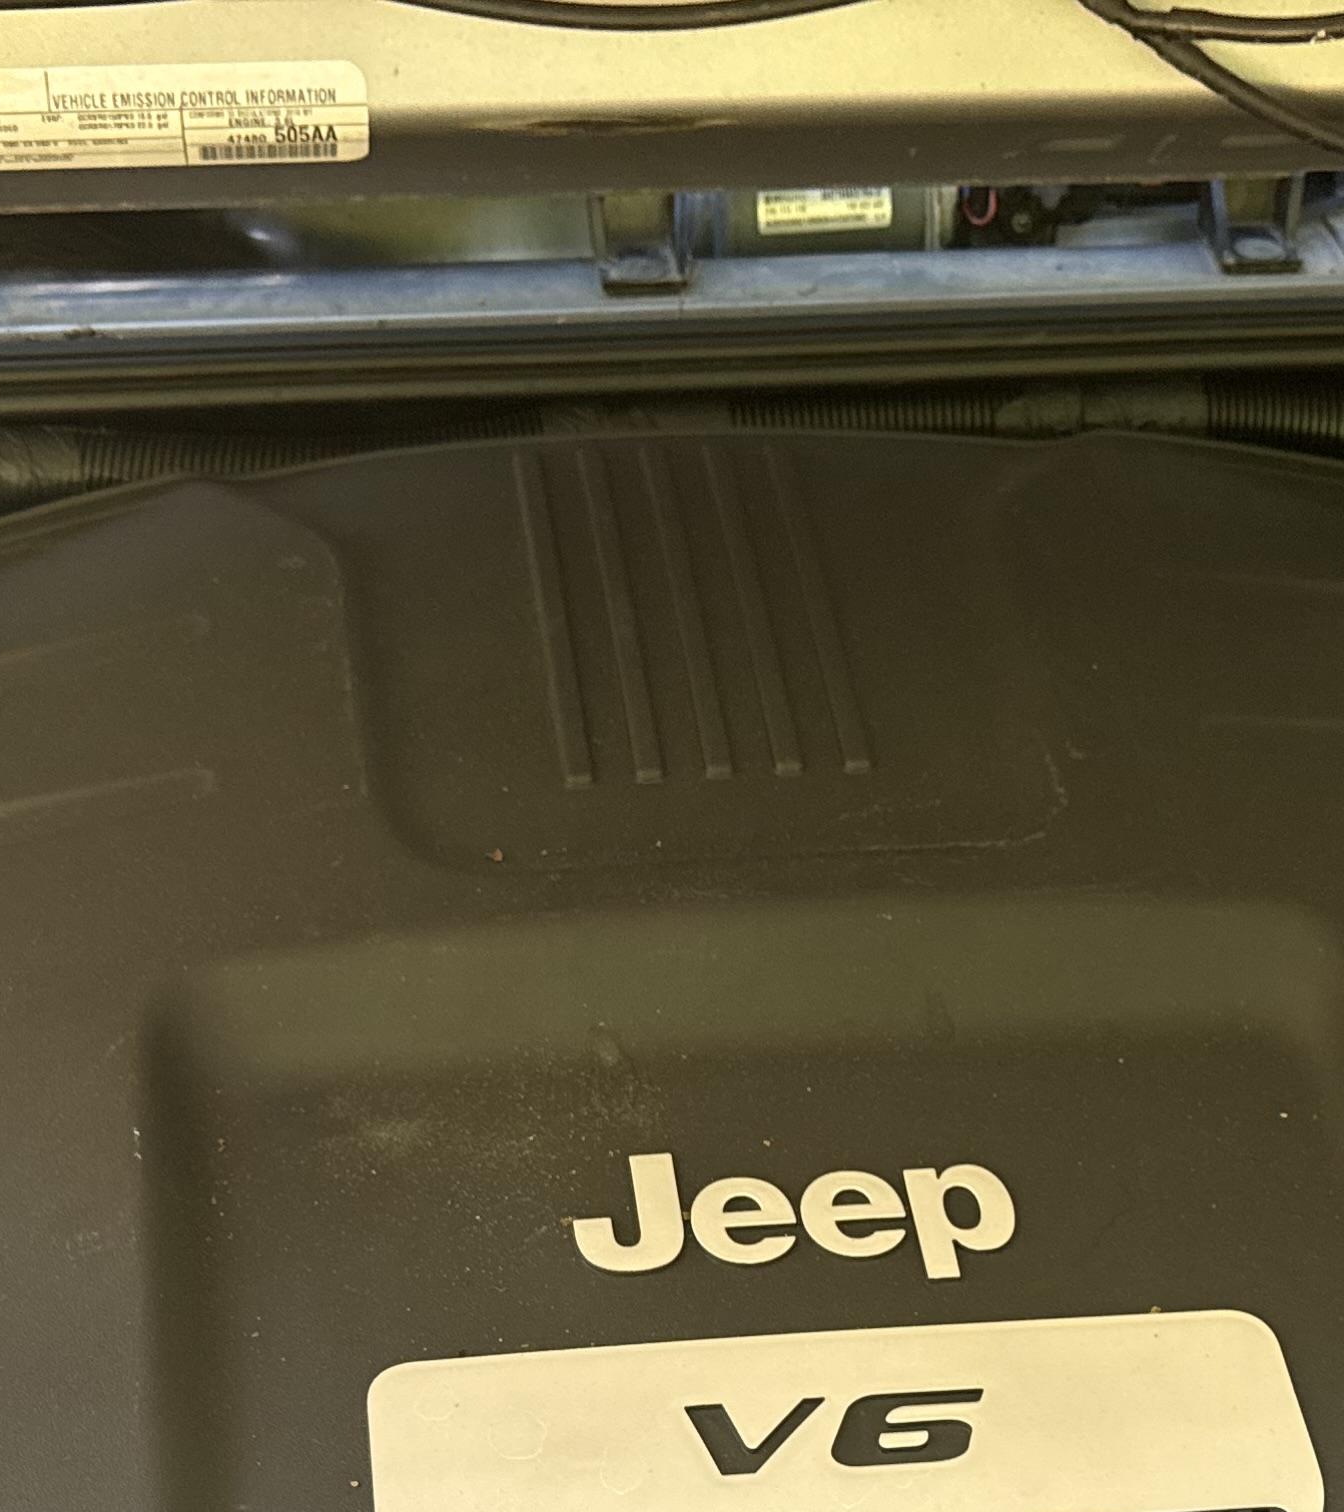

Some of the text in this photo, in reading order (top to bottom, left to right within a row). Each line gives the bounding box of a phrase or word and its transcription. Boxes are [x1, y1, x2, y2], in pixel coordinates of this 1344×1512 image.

[51, 88, 338, 110] VEHICLE EMISSION CONTROL INFORMATION
[274, 125, 339, 144] 505AA
[571, 1151, 1017, 1280] Jeep
[684, 1388, 985, 1477] V6
